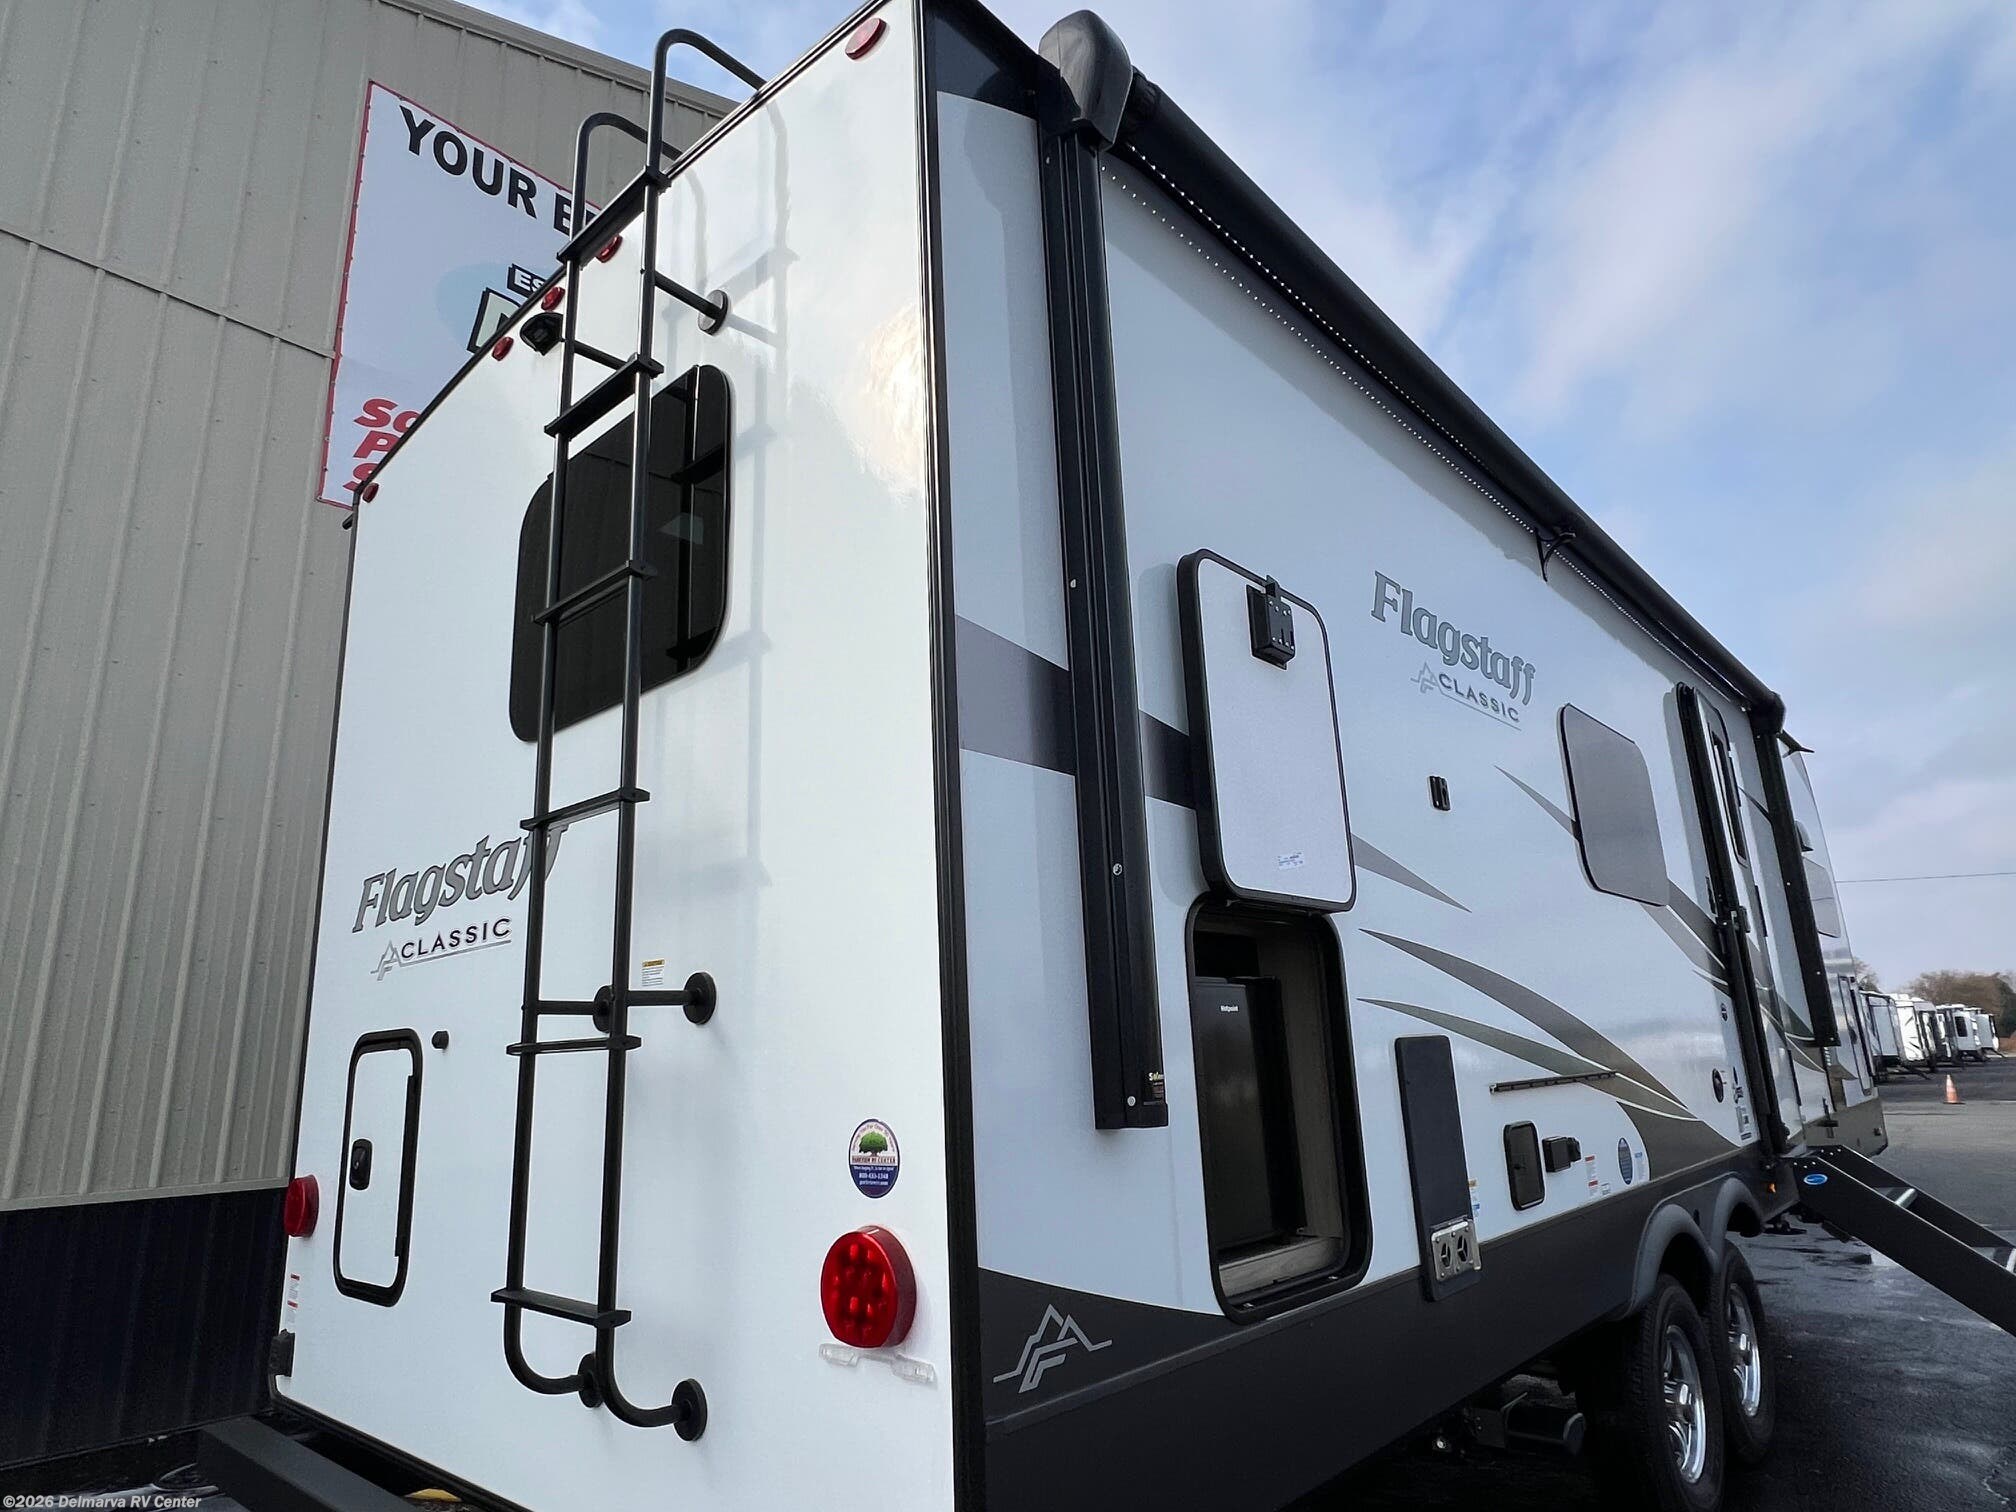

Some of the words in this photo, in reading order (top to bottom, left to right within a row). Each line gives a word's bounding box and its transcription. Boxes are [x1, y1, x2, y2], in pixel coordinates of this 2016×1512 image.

[399, 105, 538, 219] YOUR
[1371, 570, 1536, 706] Flagstaff
[1438, 673, 1520, 723] CLASSIC
[400, 917, 512, 960] CLASSIC
